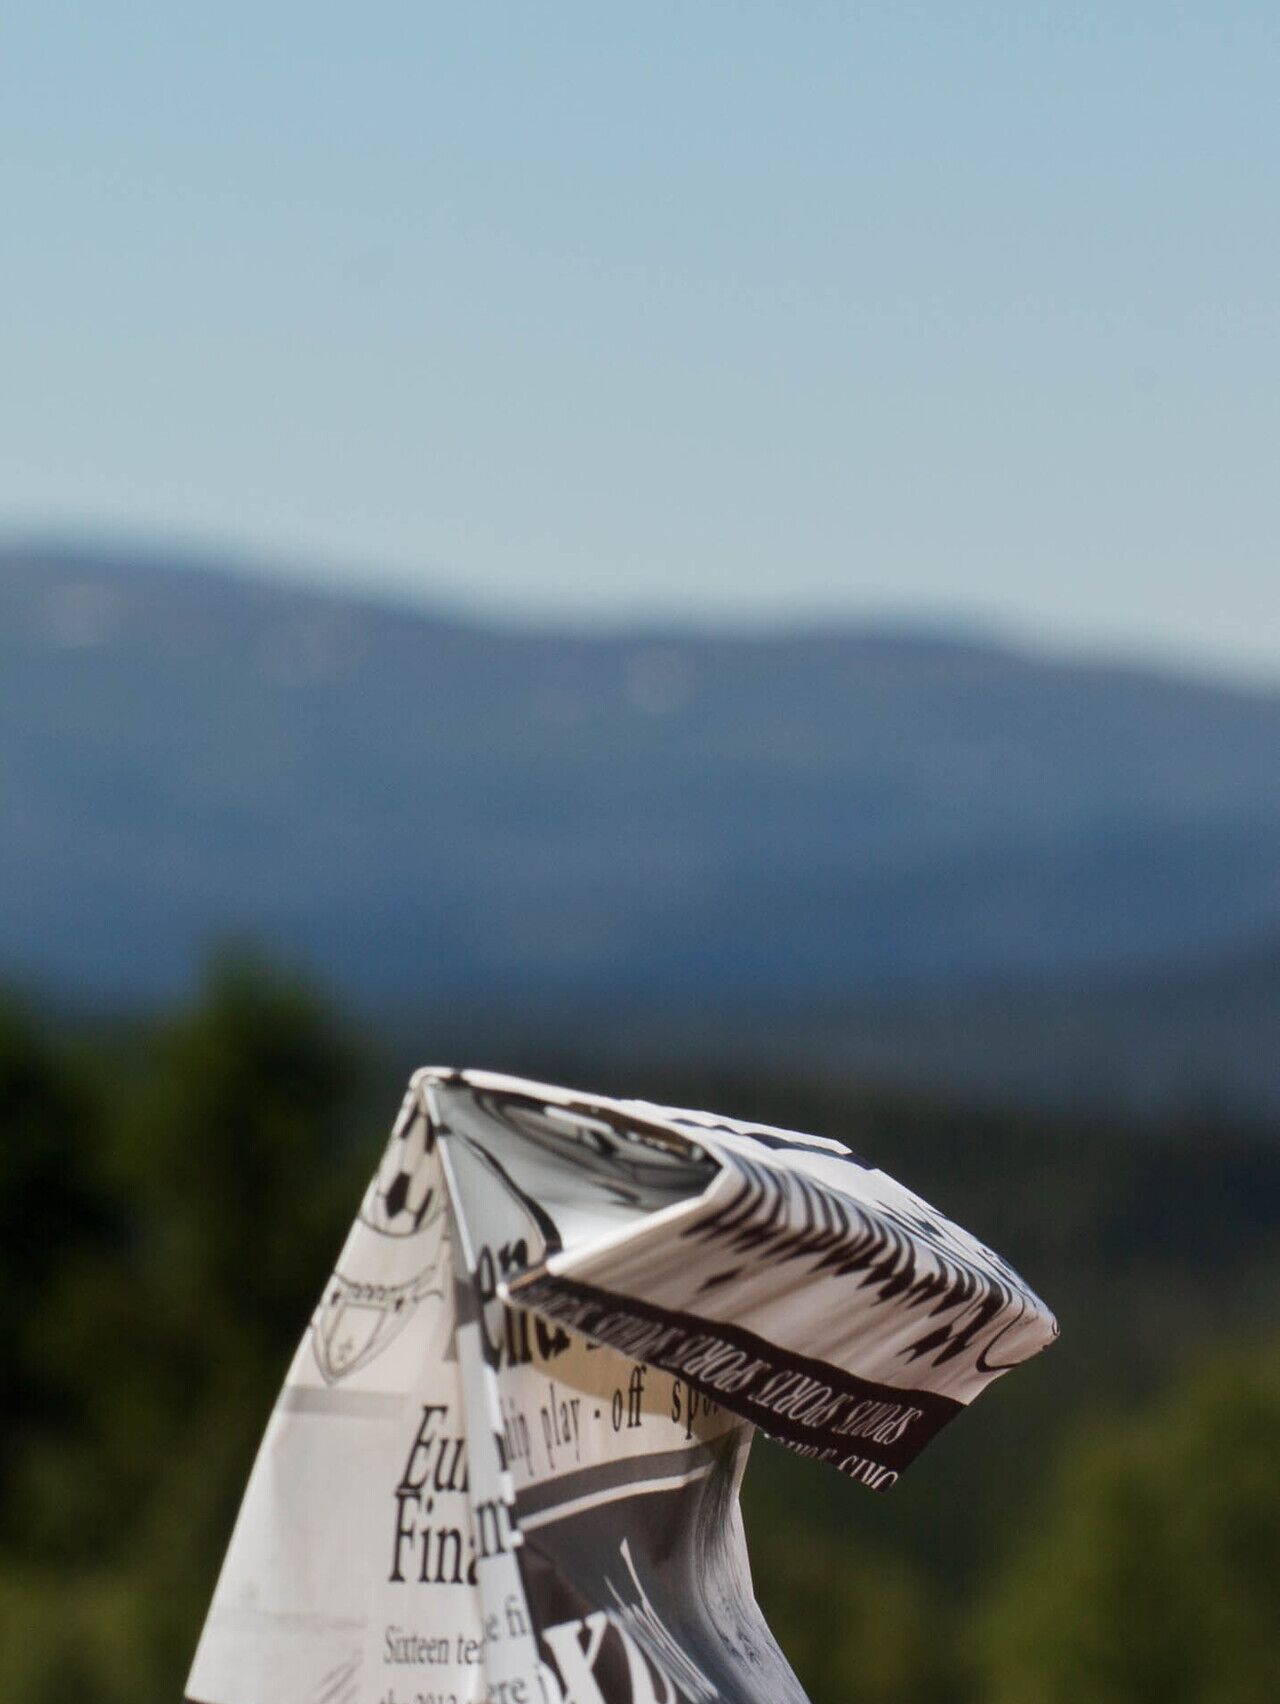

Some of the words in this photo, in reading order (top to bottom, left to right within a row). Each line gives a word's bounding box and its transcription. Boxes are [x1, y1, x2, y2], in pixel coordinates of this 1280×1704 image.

[612, 1365, 647, 1432] off
[746, 1369, 852, 1430] SPORTS
[382, 1623, 450, 1666] Sixteen
